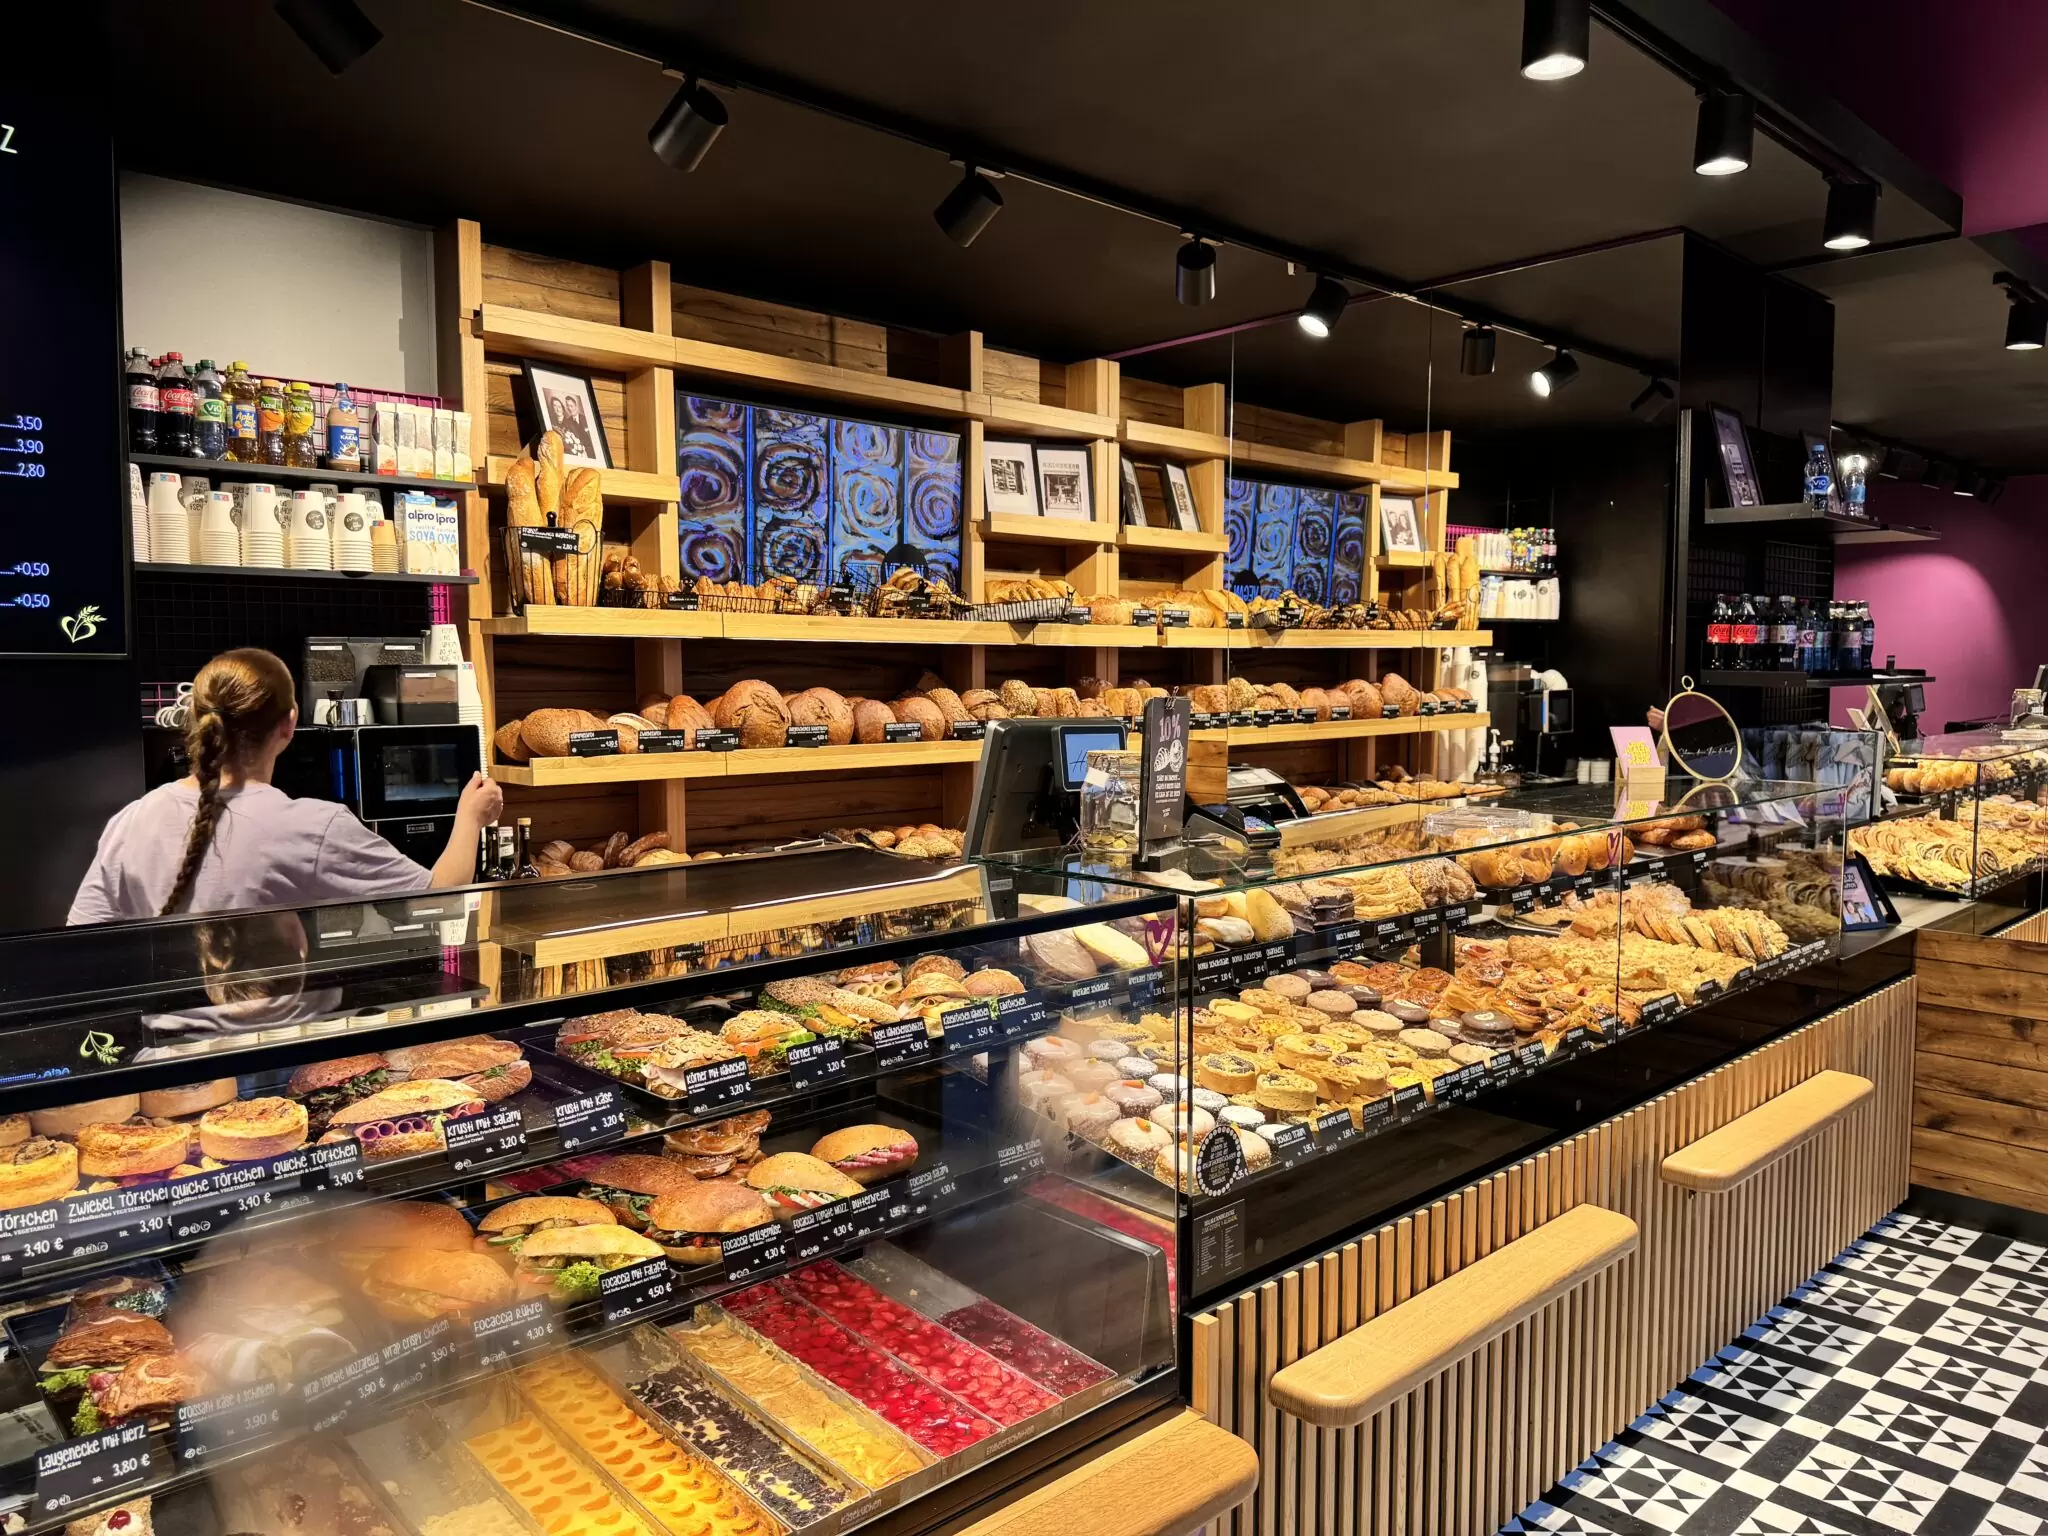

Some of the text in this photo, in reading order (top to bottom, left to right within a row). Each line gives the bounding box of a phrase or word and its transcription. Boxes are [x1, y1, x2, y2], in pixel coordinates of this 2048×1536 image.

[16, 415, 43, 431] 3,50
[17, 438, 44, 454] 3,90
[18, 462, 45, 478] 2,80
[408, 508, 435, 521] alpro
[435, 513, 456, 525] lpro
[409, 530, 435, 541] SOYA
[437, 533, 456, 544] OYA
[14, 562, 49, 576] +0,50
[14, 594, 50, 608] +0,50
[788, 1047, 810, 1061] Körner
[812, 1044, 824, 1054] mit
[824, 1040, 840, 1051] Käse
[686, 1071, 708, 1084] Körner
[708, 1067, 719, 1079] mit
[556, 1102, 579, 1117] Krusti
[580, 1097, 594, 1110] mit
[595, 1091, 614, 1106] Käse
[446, 1109, 522, 1138] Krusti mit Salami
[602, 1114, 617, 1128] 3,20
[618, 1112, 625, 1122] €
[500, 1135, 517, 1149] 3,20
[519, 1133, 526, 1144] €
[273, 1143, 358, 1175] Quiche Törtchen
[171, 1166, 265, 1199] Quiche Törtchen
[333, 1171, 354, 1187] 3,40
[356, 1169, 364, 1180] €
[220, 1181, 256, 1193] VEGETARISCH
[68, 1196, 115, 1217] Zwiebel
[238, 1194, 260, 1211] 3,40
[263, 1191, 272, 1204] €
[112, 1204, 151, 1216] VEGETARISCH
[14, 1223, 55, 1236] VEGETARISCH
[139, 1216, 163, 1234] 3,40
[24, 1240, 50, 1257] 3,40
[54, 1237, 64, 1251] €
[723, 1235, 748, 1251] Focaccia
[765, 1247, 779, 1260] 4,30
[780, 1244, 786, 1254] €
[601, 1259, 668, 1290] Focaccia mit Falafel
[648, 1282, 672, 1298] 4,50 €
[474, 1310, 513, 1333] Focaccia
[516, 1301, 543, 1319] Rührei
[527, 1326, 544, 1340] 4,30
[546, 1322, 553, 1334] €
[431, 1346, 448, 1363] 3,90
[358, 1381, 376, 1399] 3,90
[179, 1399, 214, 1420] Croissant
[244, 1413, 267, 1430] 3,90
[39, 1424, 146, 1471] Laugenecke mit Herz
[112, 1457, 137, 1477] 3,80
[140, 1453, 151, 1467] €
